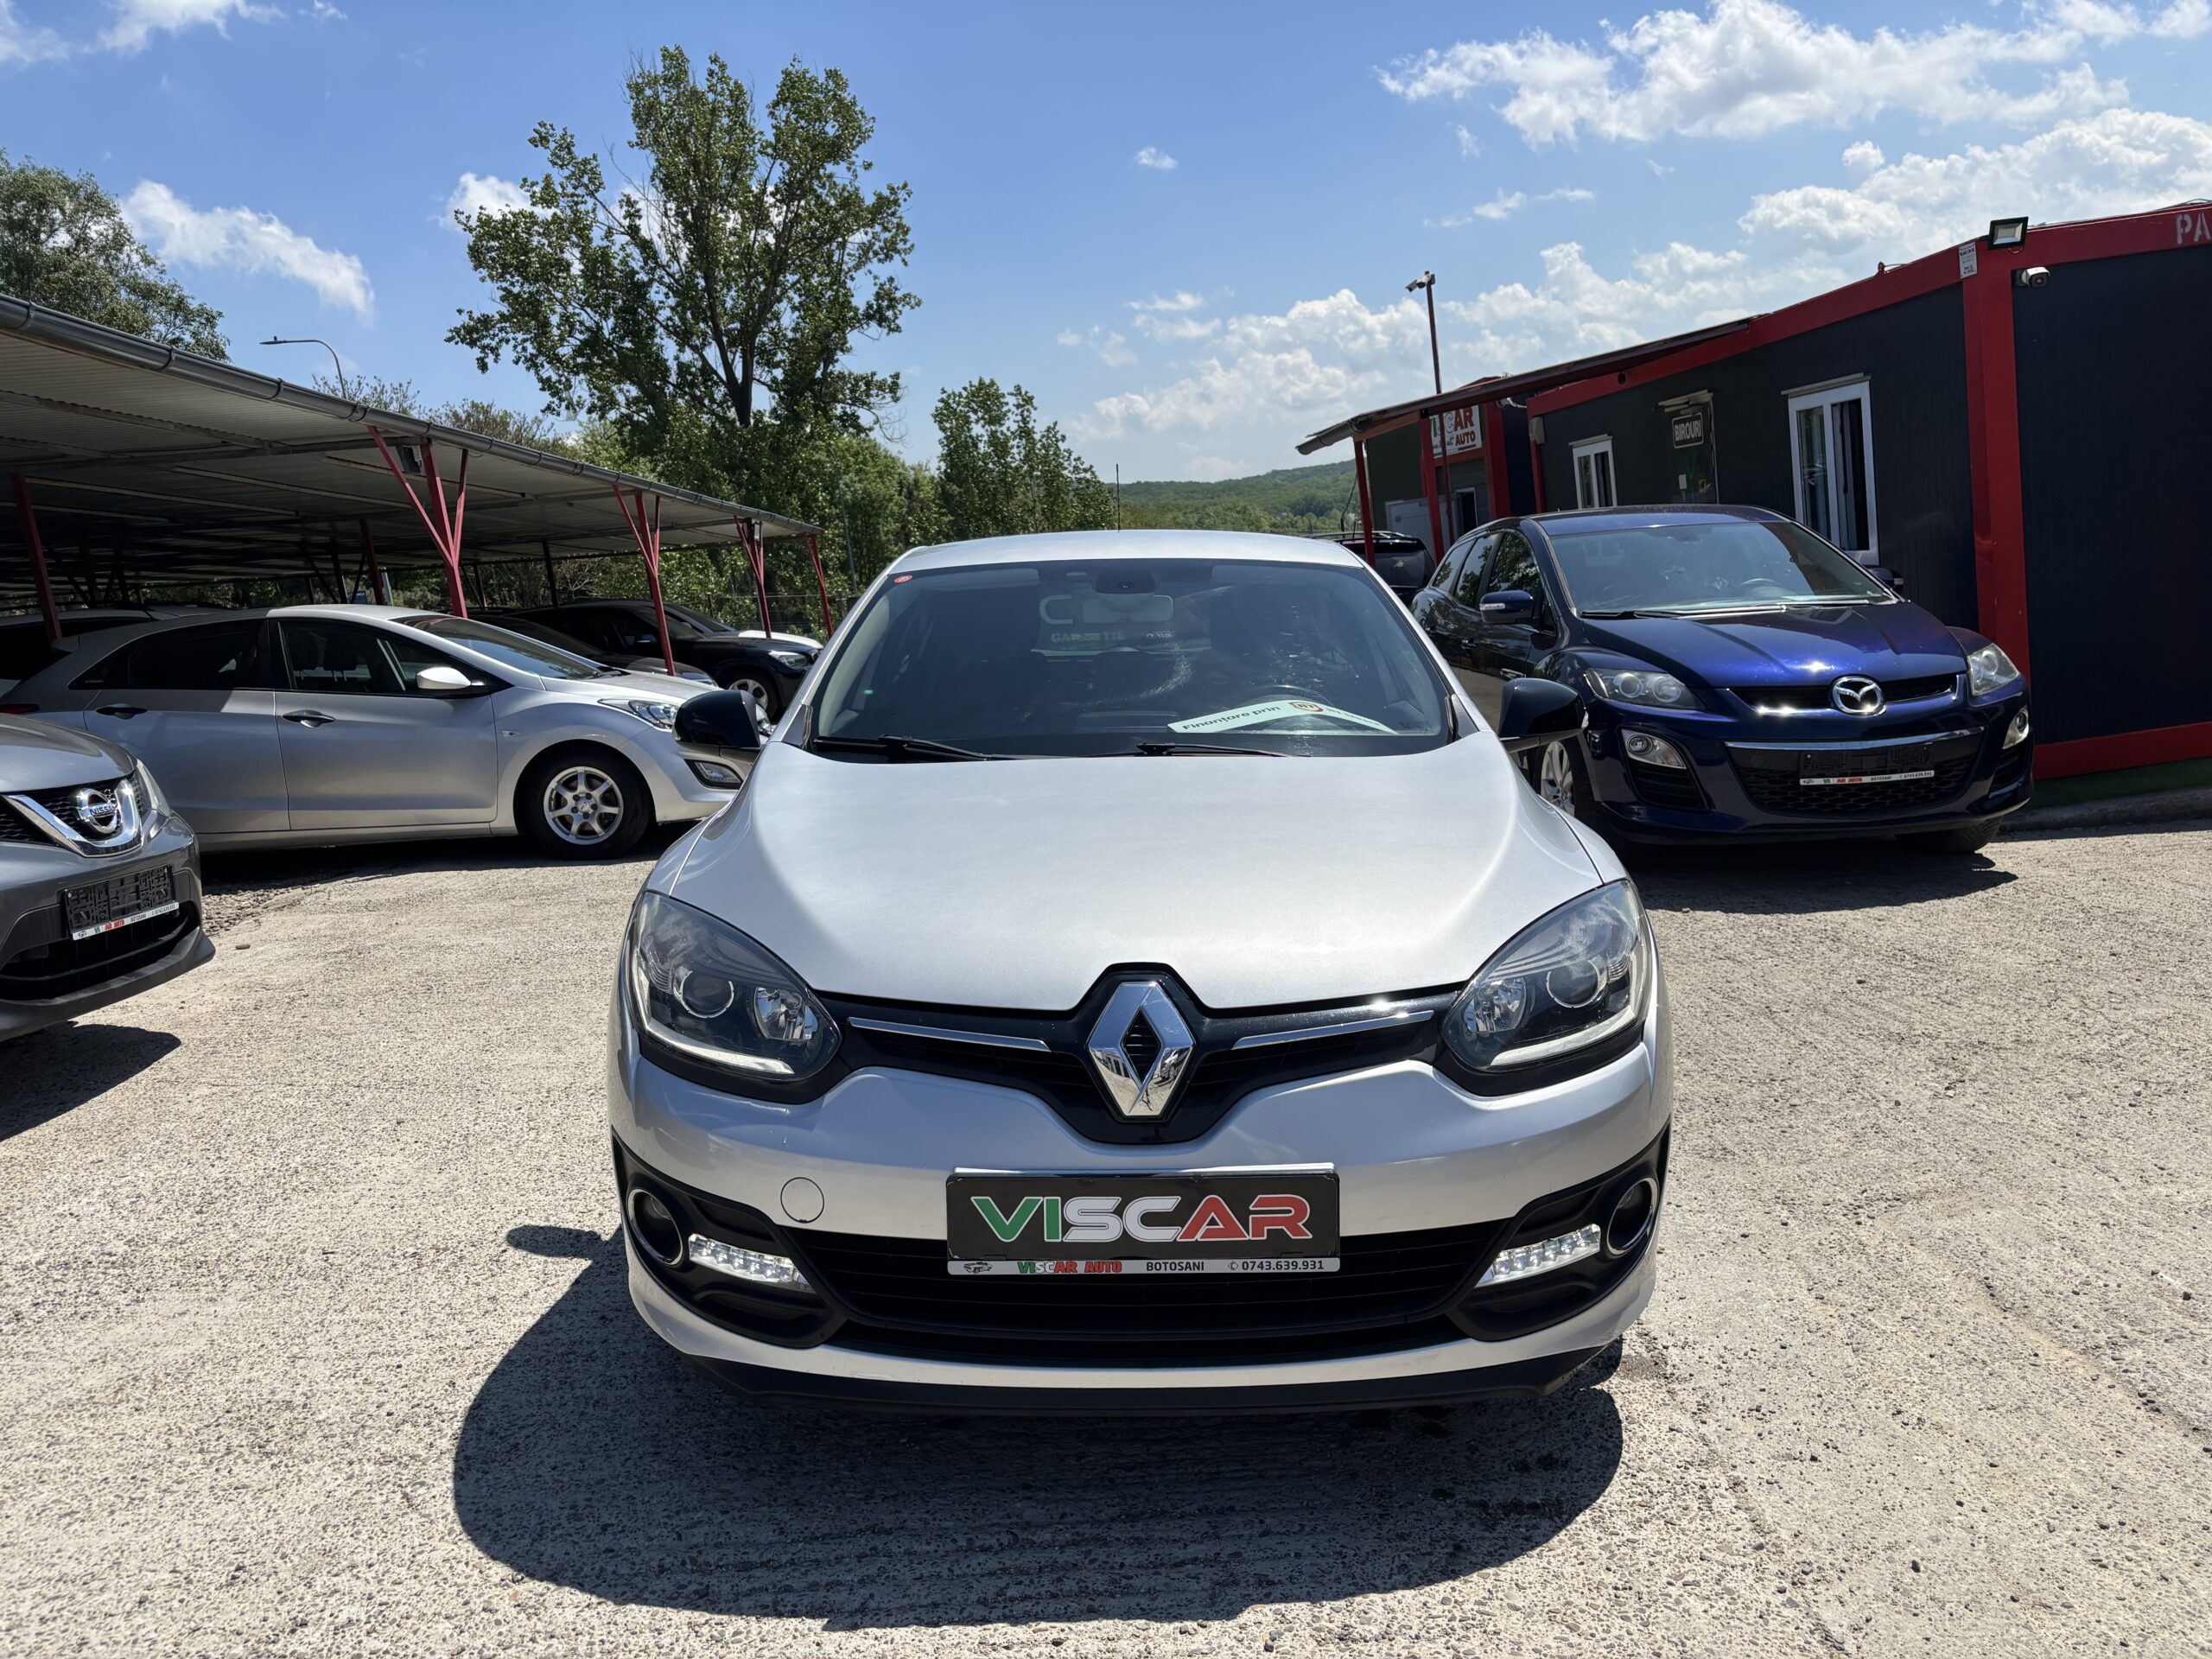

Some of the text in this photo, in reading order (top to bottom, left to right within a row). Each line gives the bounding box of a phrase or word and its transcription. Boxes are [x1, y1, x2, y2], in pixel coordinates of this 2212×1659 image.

[1455, 430, 1476, 446] AUTO
[1674, 419, 1702, 442] BIROURI
[1252, 705, 1281, 716] prin
[969, 1193, 1313, 1243] VISCAR
[1016, 1259, 1325, 1274] VISCAR AUTO BOTOSANI 0743.639.931
